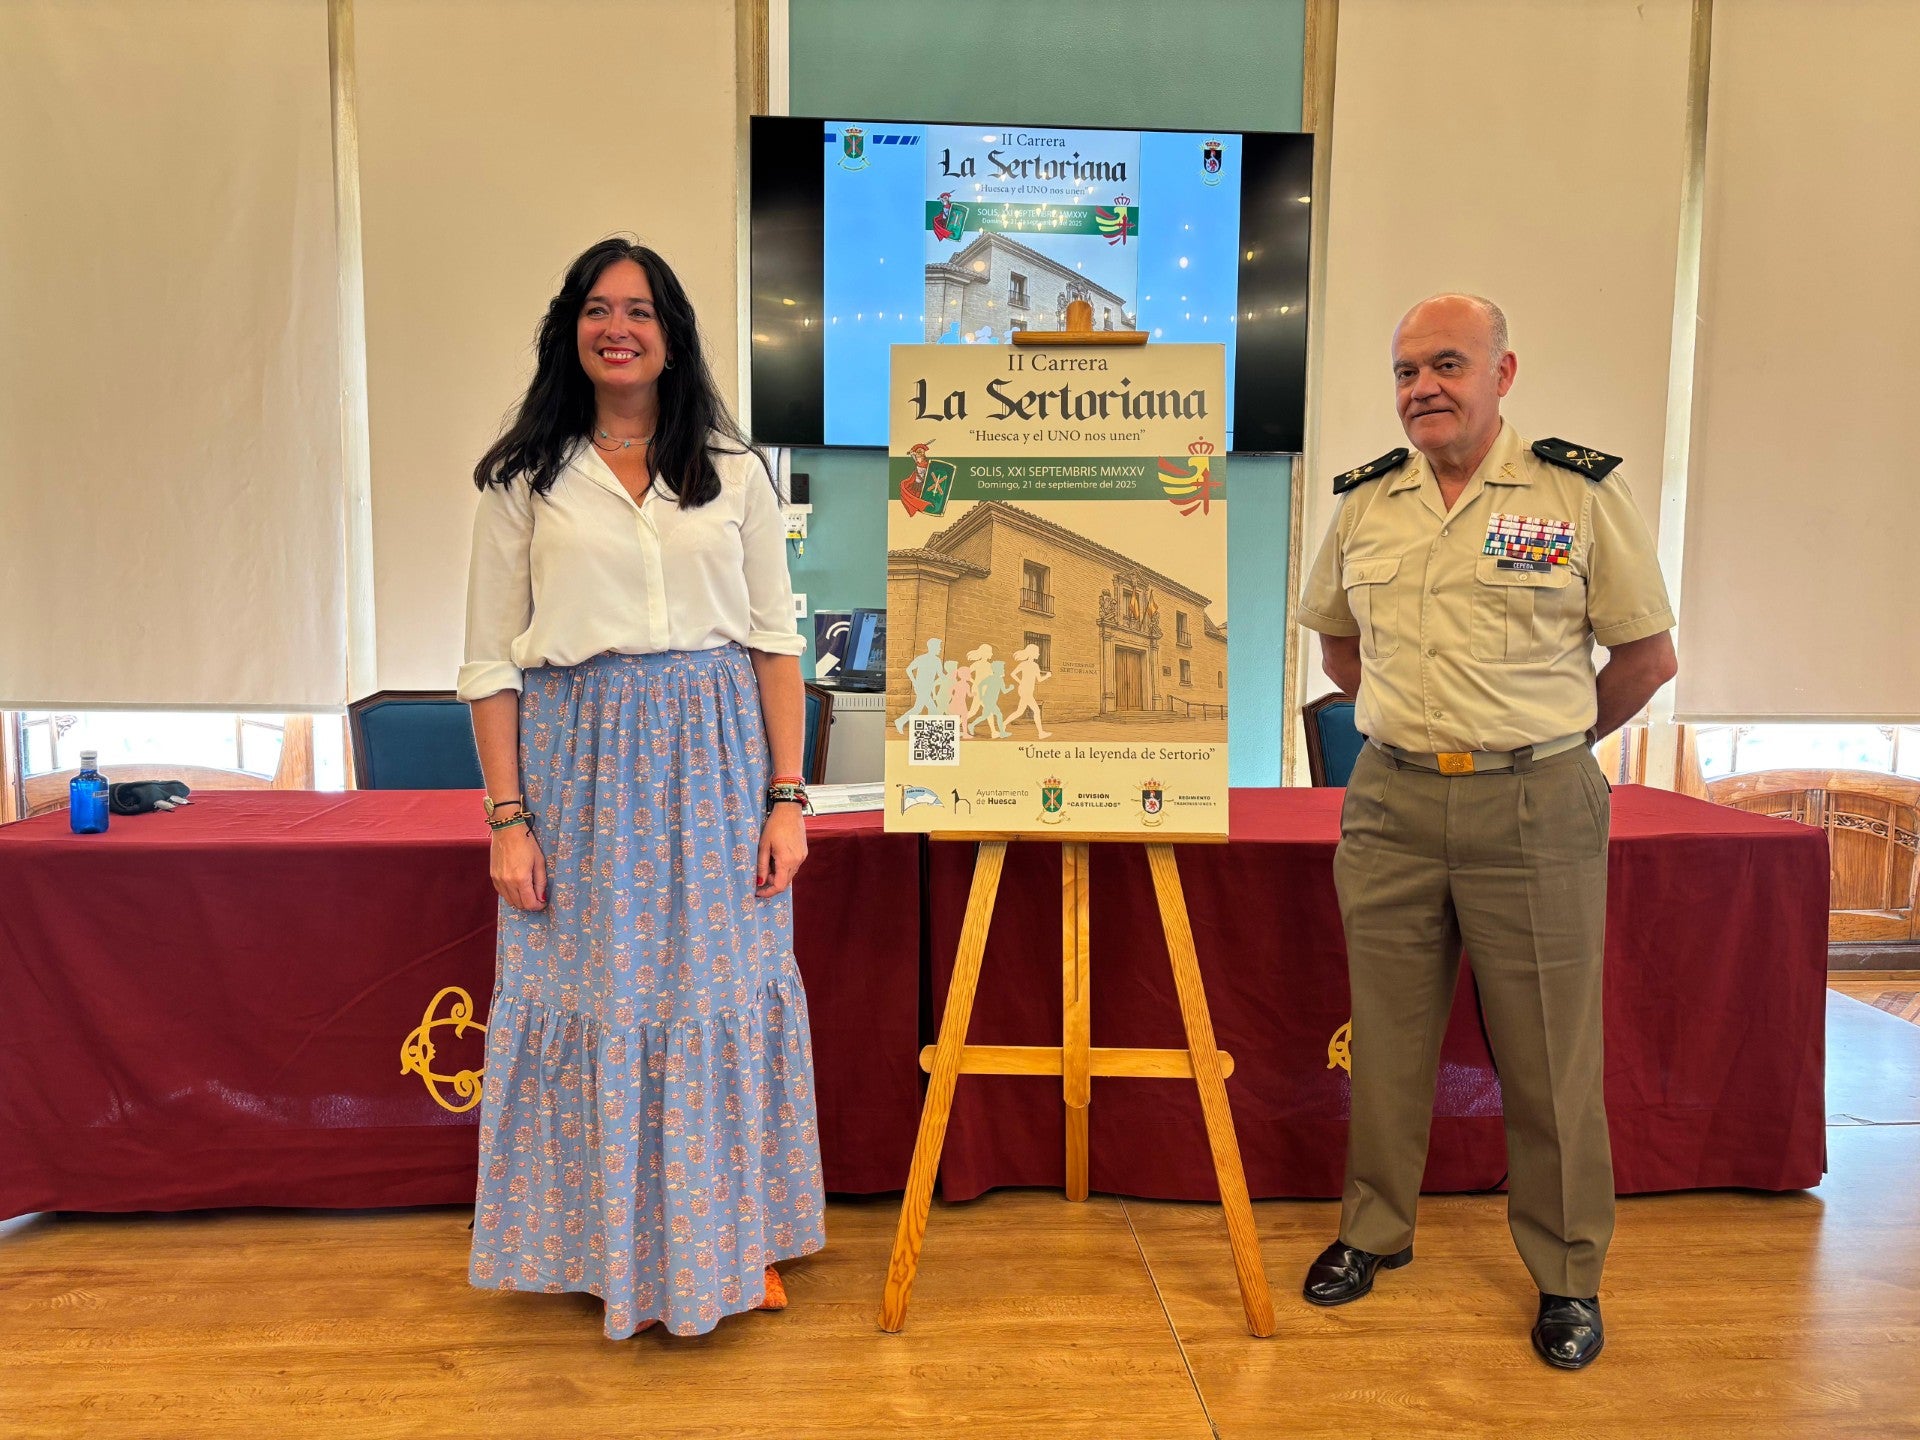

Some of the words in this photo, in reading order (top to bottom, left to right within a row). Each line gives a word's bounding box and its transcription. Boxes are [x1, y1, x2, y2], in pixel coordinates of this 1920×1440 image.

[1002, 133, 1012, 146] II
[1016, 133, 1066, 147] Carrera
[938, 148, 976, 179] La
[987, 149, 1127, 183] Sertoriana
[1018, 185, 1025, 194] el
[1027, 185, 1048, 194] UNO
[1050, 187, 1064, 195] nos
[1007, 354, 1023, 371] II
[1031, 354, 1109, 371] Carrera
[908, 378, 968, 422] La
[985, 377, 1209, 421] Sertoriana
[1022, 433, 1030, 445] y
[1033, 429, 1044, 442] el
[1047, 430, 1081, 442] UNO
[1084, 433, 1106, 442] nos
[970, 466, 1005, 479] SOLIS,
[1007, 466, 1026, 477] XXI
[1029, 466, 1098, 478] SEPTEMBRIS
[1100, 466, 1145, 478] MMXXV
[977, 480, 1021, 491] Domingo,
[1022, 480, 1033, 489] 21
[1035, 480, 1046, 489] de
[1048, 480, 1098, 491] septiembre
[1100, 480, 1113, 489] del
[1115, 480, 1137, 490] 2025
[1064, 749, 1071, 760] a
[1074, 746, 1086, 760] la
[1089, 746, 1137, 763] leyenda
[1141, 746, 1156, 760] de
[976, 788, 1029, 798] Ayuntamiento
[976, 797, 986, 805] de
[987, 797, 1017, 805] Huesca
